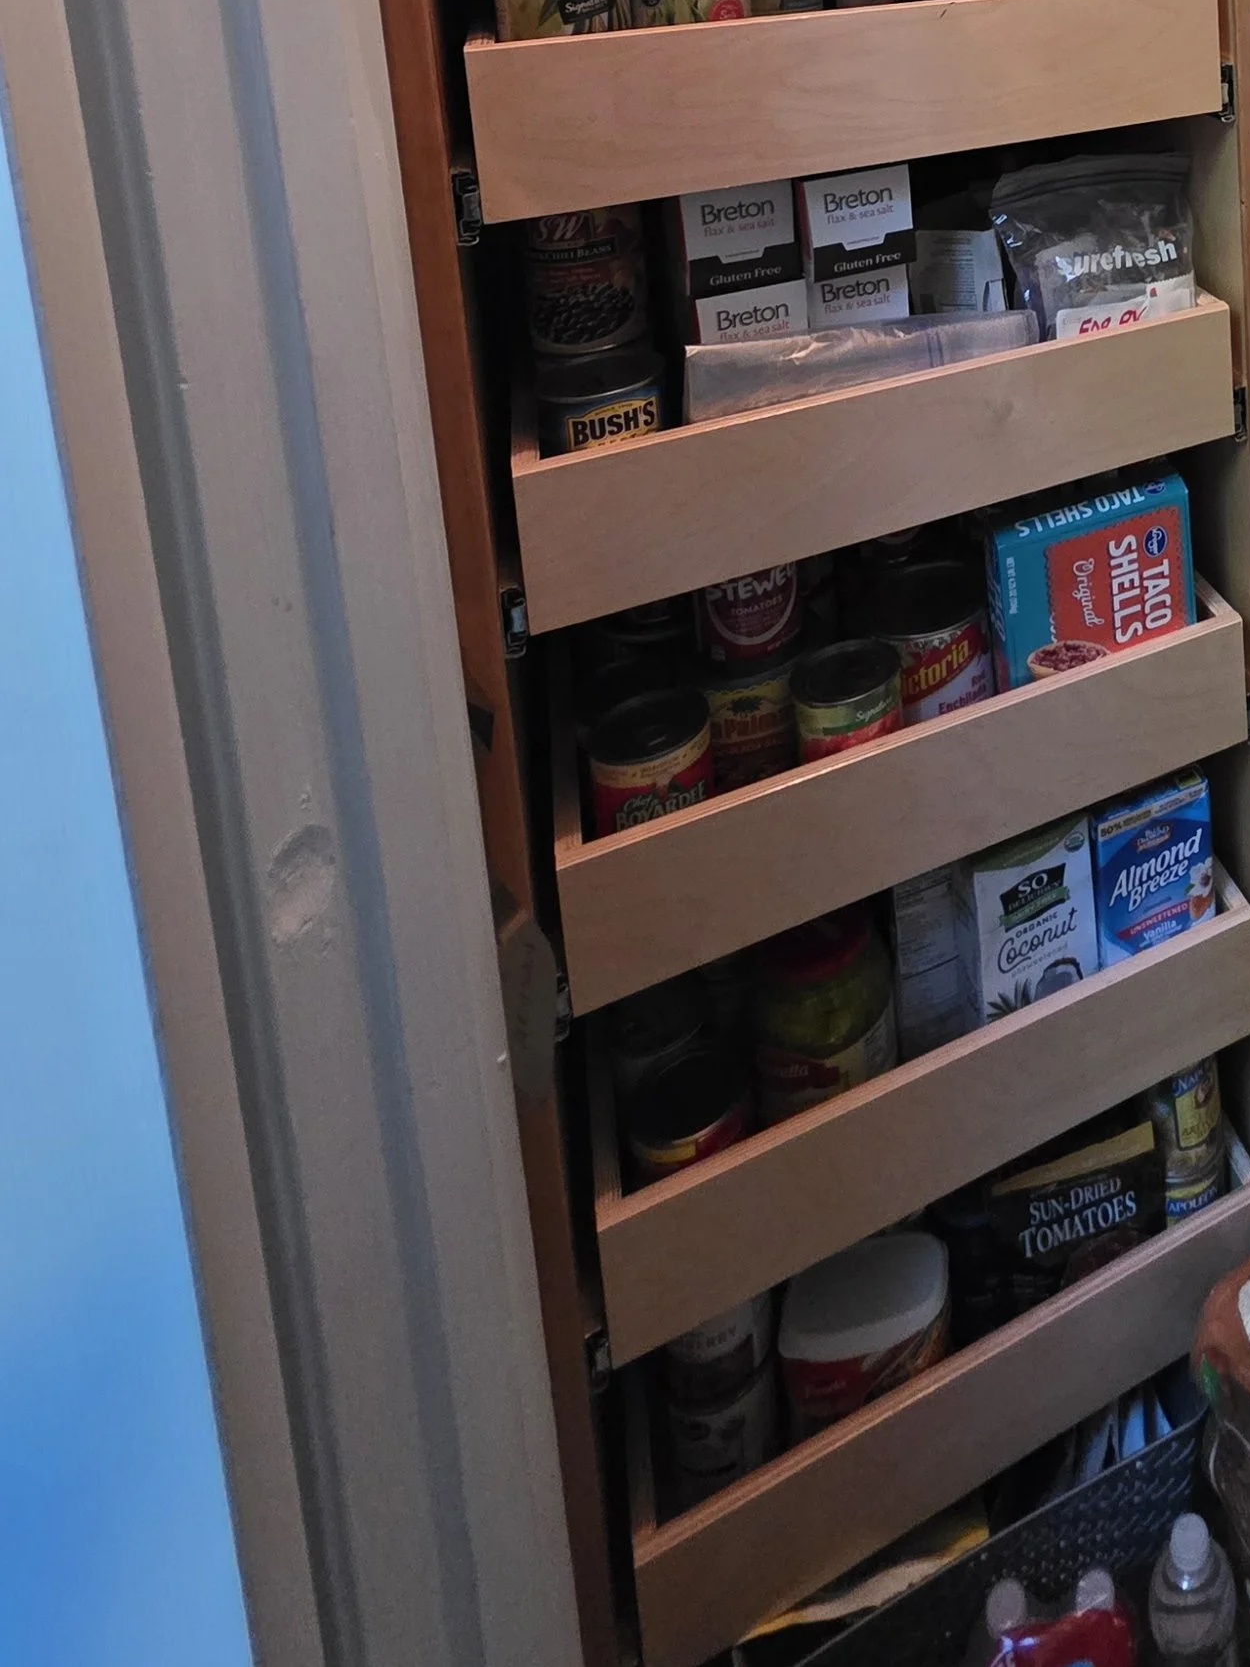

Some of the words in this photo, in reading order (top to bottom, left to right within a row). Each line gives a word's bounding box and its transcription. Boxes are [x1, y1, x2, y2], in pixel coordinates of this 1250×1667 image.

[701, 199, 775, 226] Breton
[823, 187, 893, 214] Breton
[827, 214, 846, 225] flax
[859, 209, 875, 219] sea
[877, 204, 895, 216] salt
[704, 224, 724, 237] flax
[726, 224, 735, 234] &
[738, 221, 755, 231] sea
[757, 218, 775, 230] salt
[576, 243, 613, 260] BEANS
[834, 258, 873, 273] Gluten
[875, 251, 901, 264] Free
[1056, 240, 1178, 277] surefresh
[710, 271, 751, 286] Gluten
[754, 265, 782, 277] Free
[821, 278, 890, 303] Breton
[824, 303, 843, 314] flax
[856, 298, 873, 308] sea
[874, 294, 891, 305] salt
[716, 302, 790, 331] Breton
[720, 330, 739, 340] flax
[753, 326, 770, 336] sea
[771, 321, 790, 333] salt
[572, 400, 656, 447] BUSH'S
[1097, 485, 1146, 513] TACO
[1014, 503, 1094, 537] SHELLS
[1071, 557, 1105, 628] Original
[1108, 534, 1143, 644] SHELLS
[1143, 558, 1172, 630] TACO
[903, 639, 969, 696] ictoria
[615, 780, 707, 831] BOYARDEE
[623, 796, 658, 813] Chef
[1101, 822, 1122, 837] 50%
[1109, 828, 1202, 907] Almond
[1018, 872, 1048, 898] SO
[1128, 861, 1189, 912] Breeze
[1015, 912, 1058, 939] ORGANIC
[1130, 903, 1189, 936] UNSWEETENED
[1142, 919, 1177, 941] Vanilla
[997, 907, 1077, 974] Coconut
[1029, 1177, 1122, 1225] SUN-DRIED
[1168, 1185, 1218, 1214] APOLEON
[1018, 1191, 1137, 1259] TOMATOES
